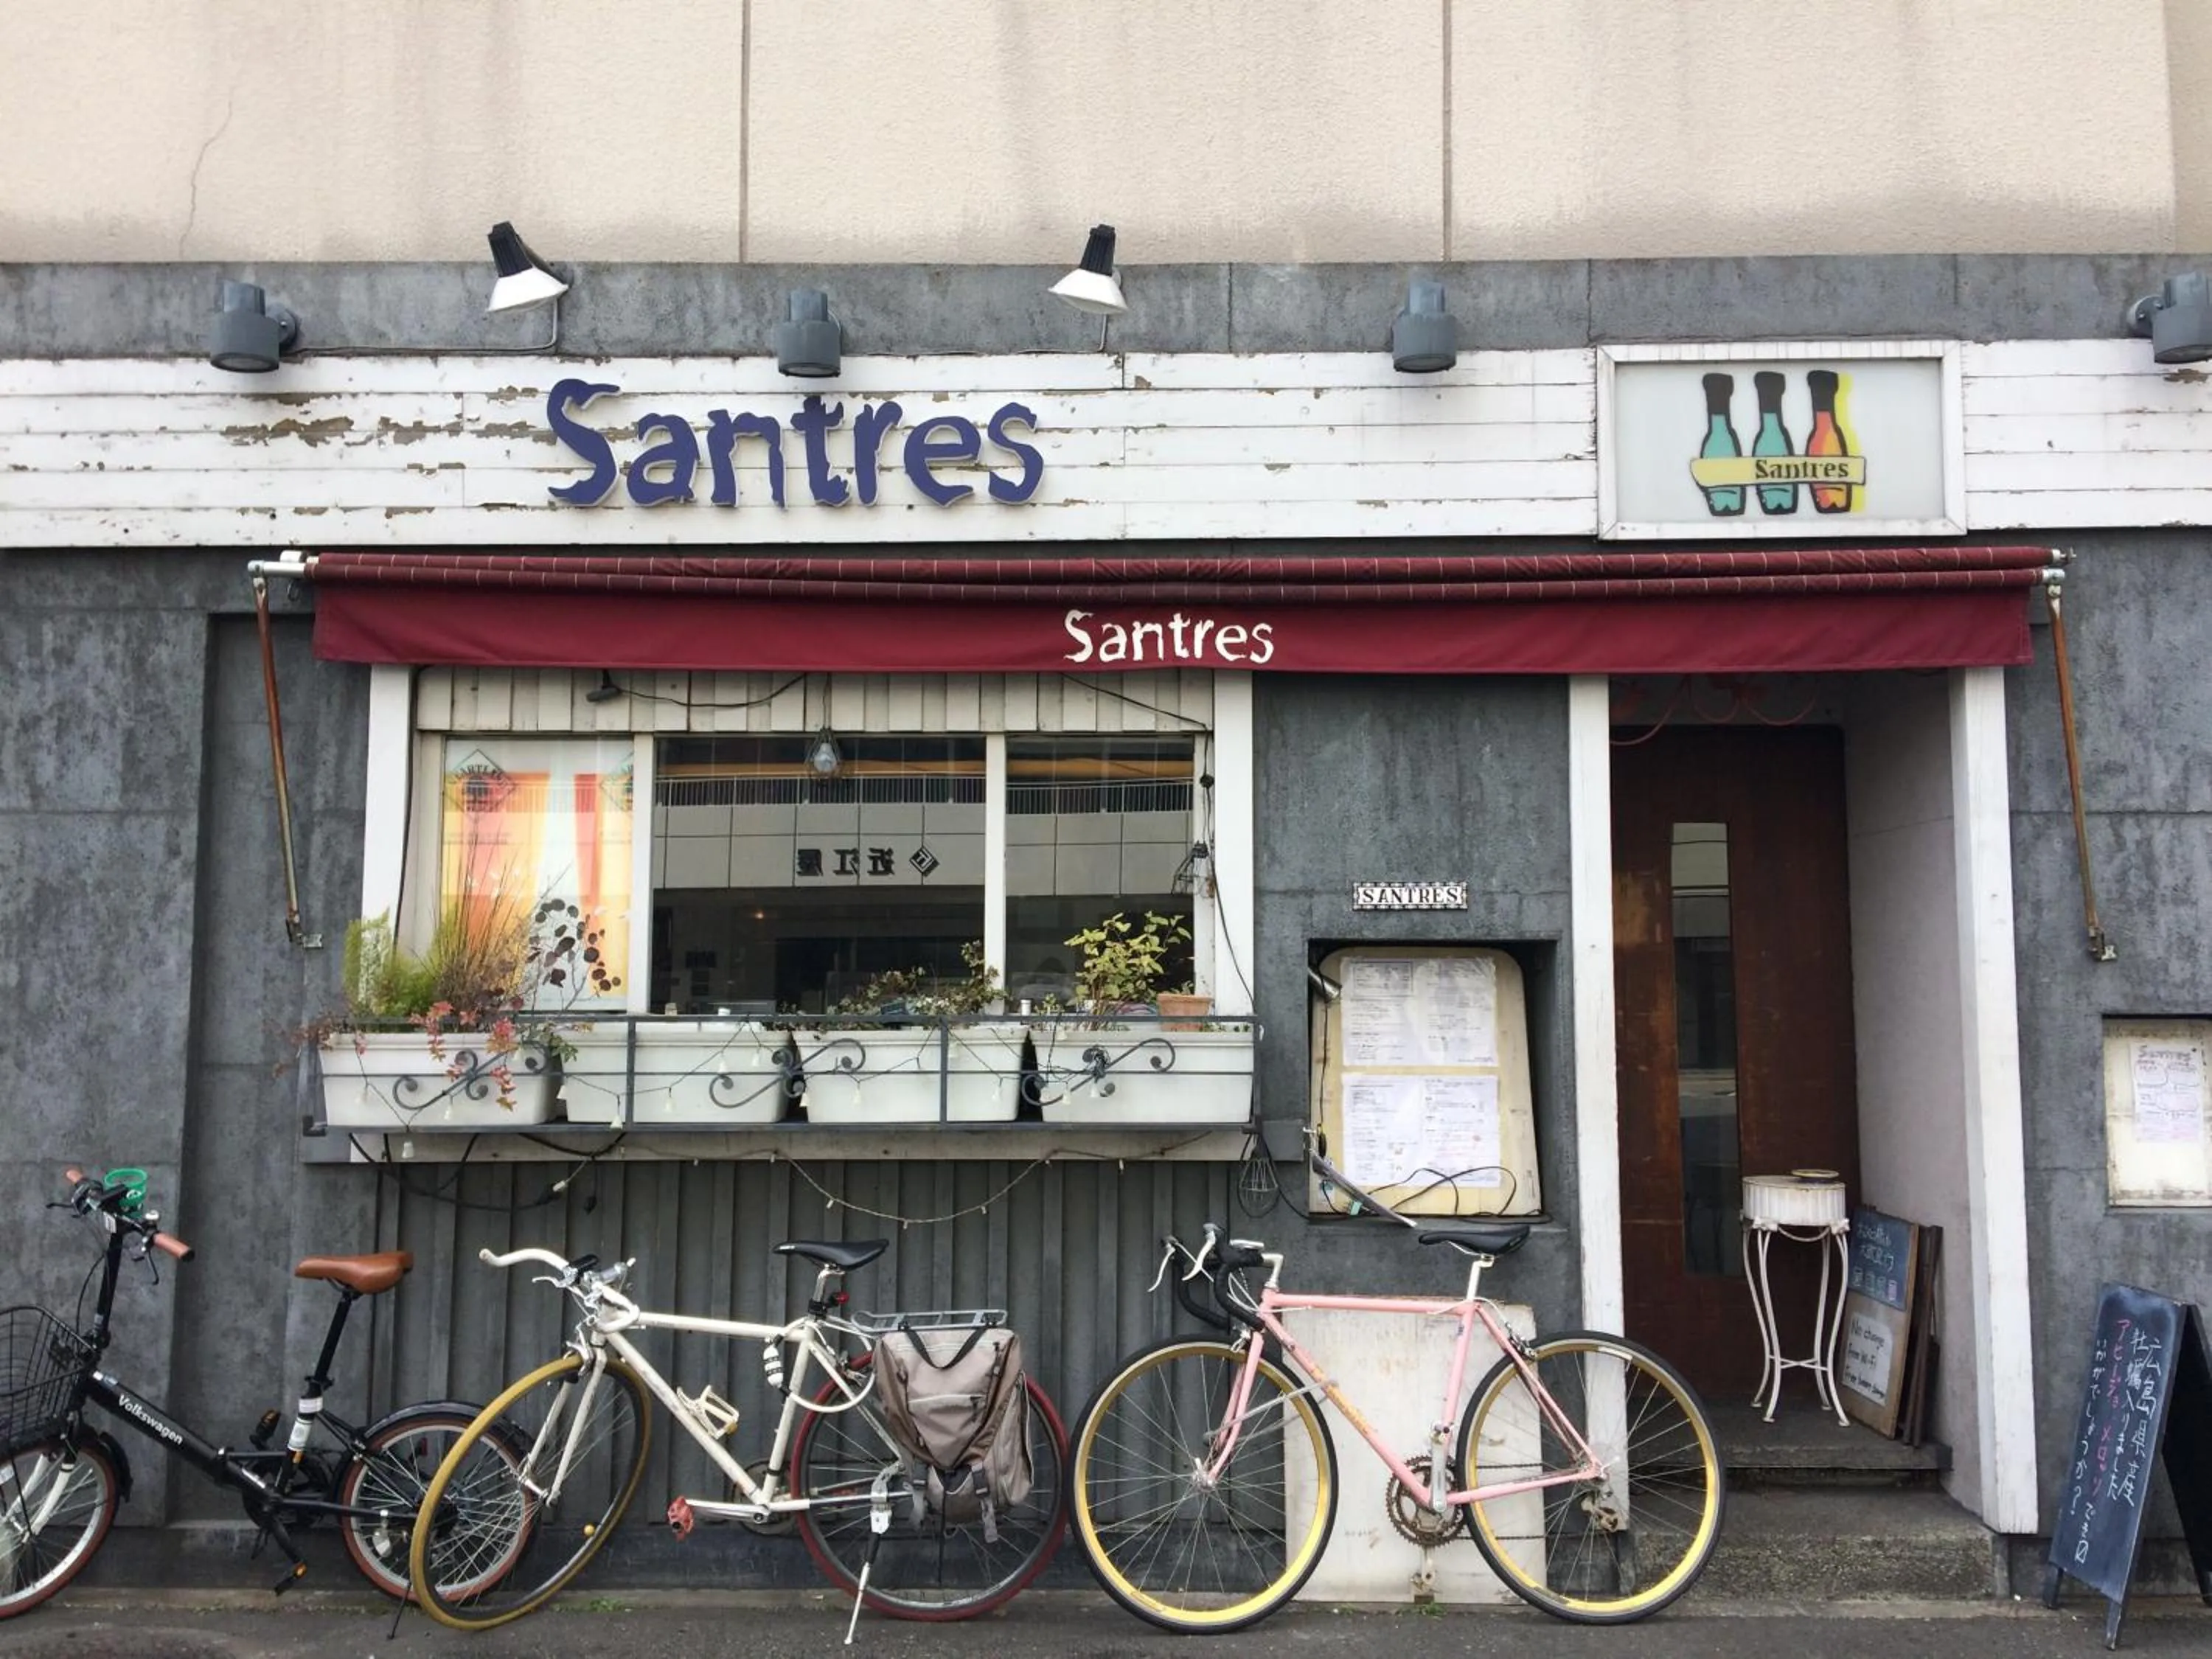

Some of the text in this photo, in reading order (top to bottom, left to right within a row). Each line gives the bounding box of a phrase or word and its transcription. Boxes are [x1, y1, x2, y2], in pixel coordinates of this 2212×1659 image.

[547, 378, 1044, 508] Santres
[1755, 459, 1849, 479] Santres
[1064, 609, 1274, 663] Santres
[1363, 887, 1459, 903] SANTRES
[118, 1393, 184, 1445] Volkswagen
